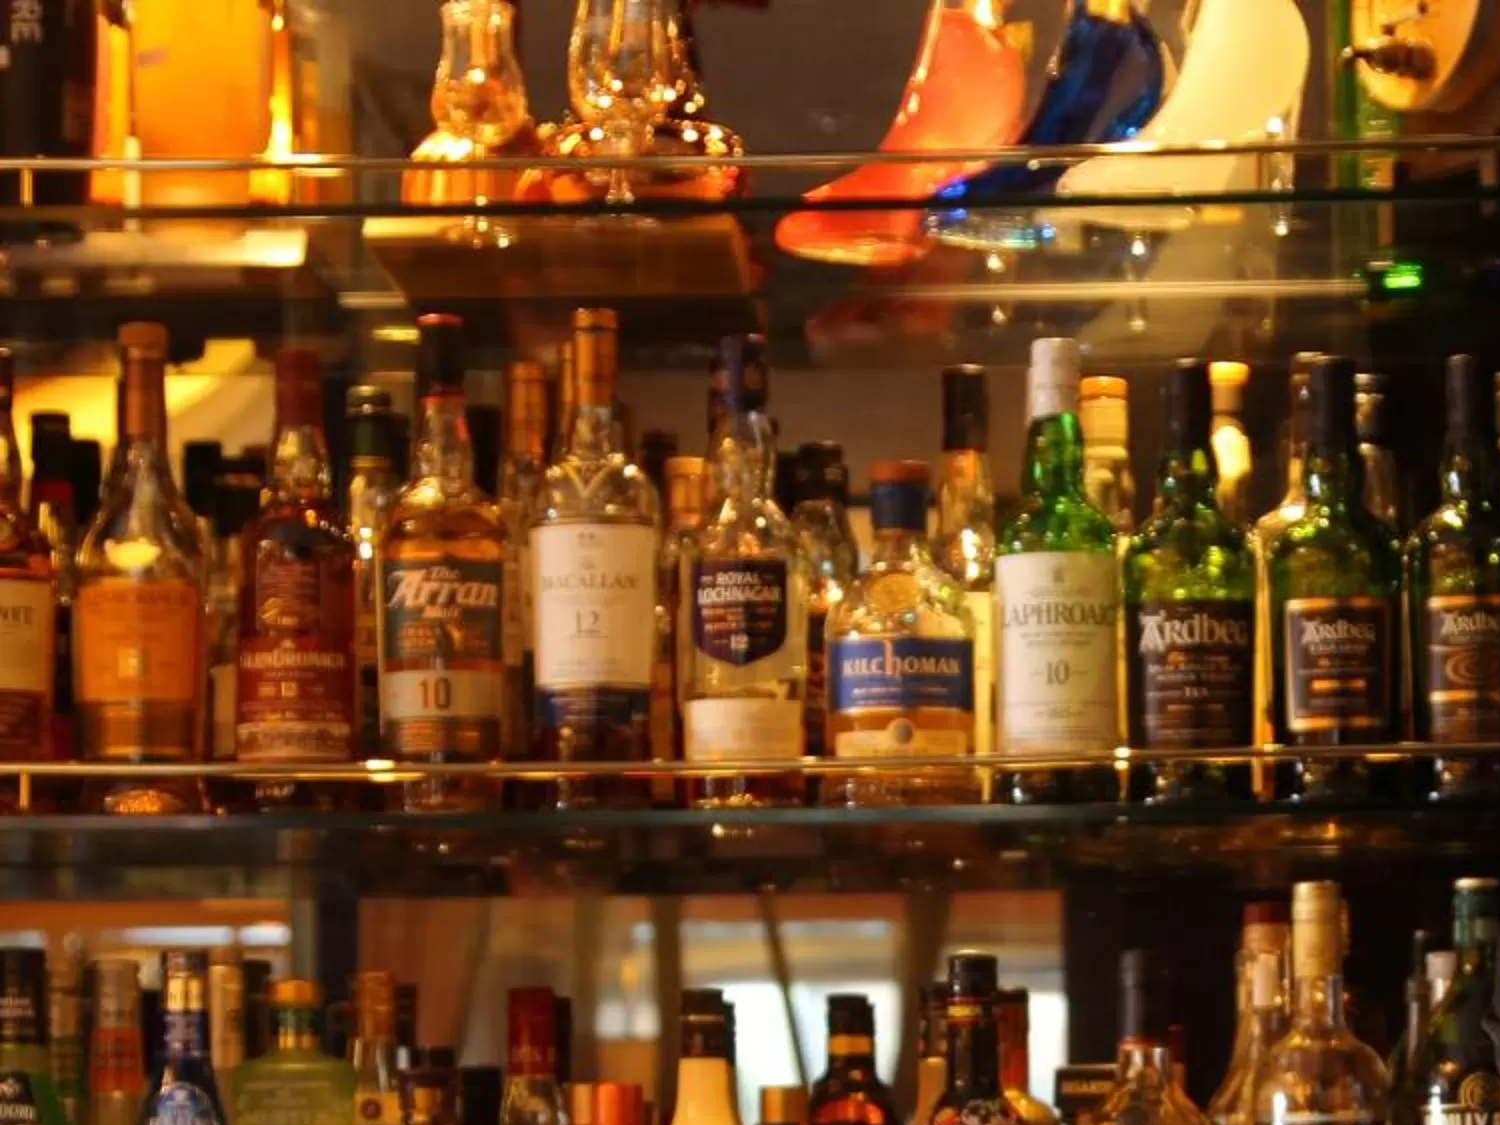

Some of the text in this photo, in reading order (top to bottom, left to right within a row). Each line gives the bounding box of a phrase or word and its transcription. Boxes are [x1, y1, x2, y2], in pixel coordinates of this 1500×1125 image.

[382, 568, 497, 608] Arran
[575, 609, 602, 634] 12
[1045, 660, 1071, 685] 10
[418, 676, 452, 711] 10
